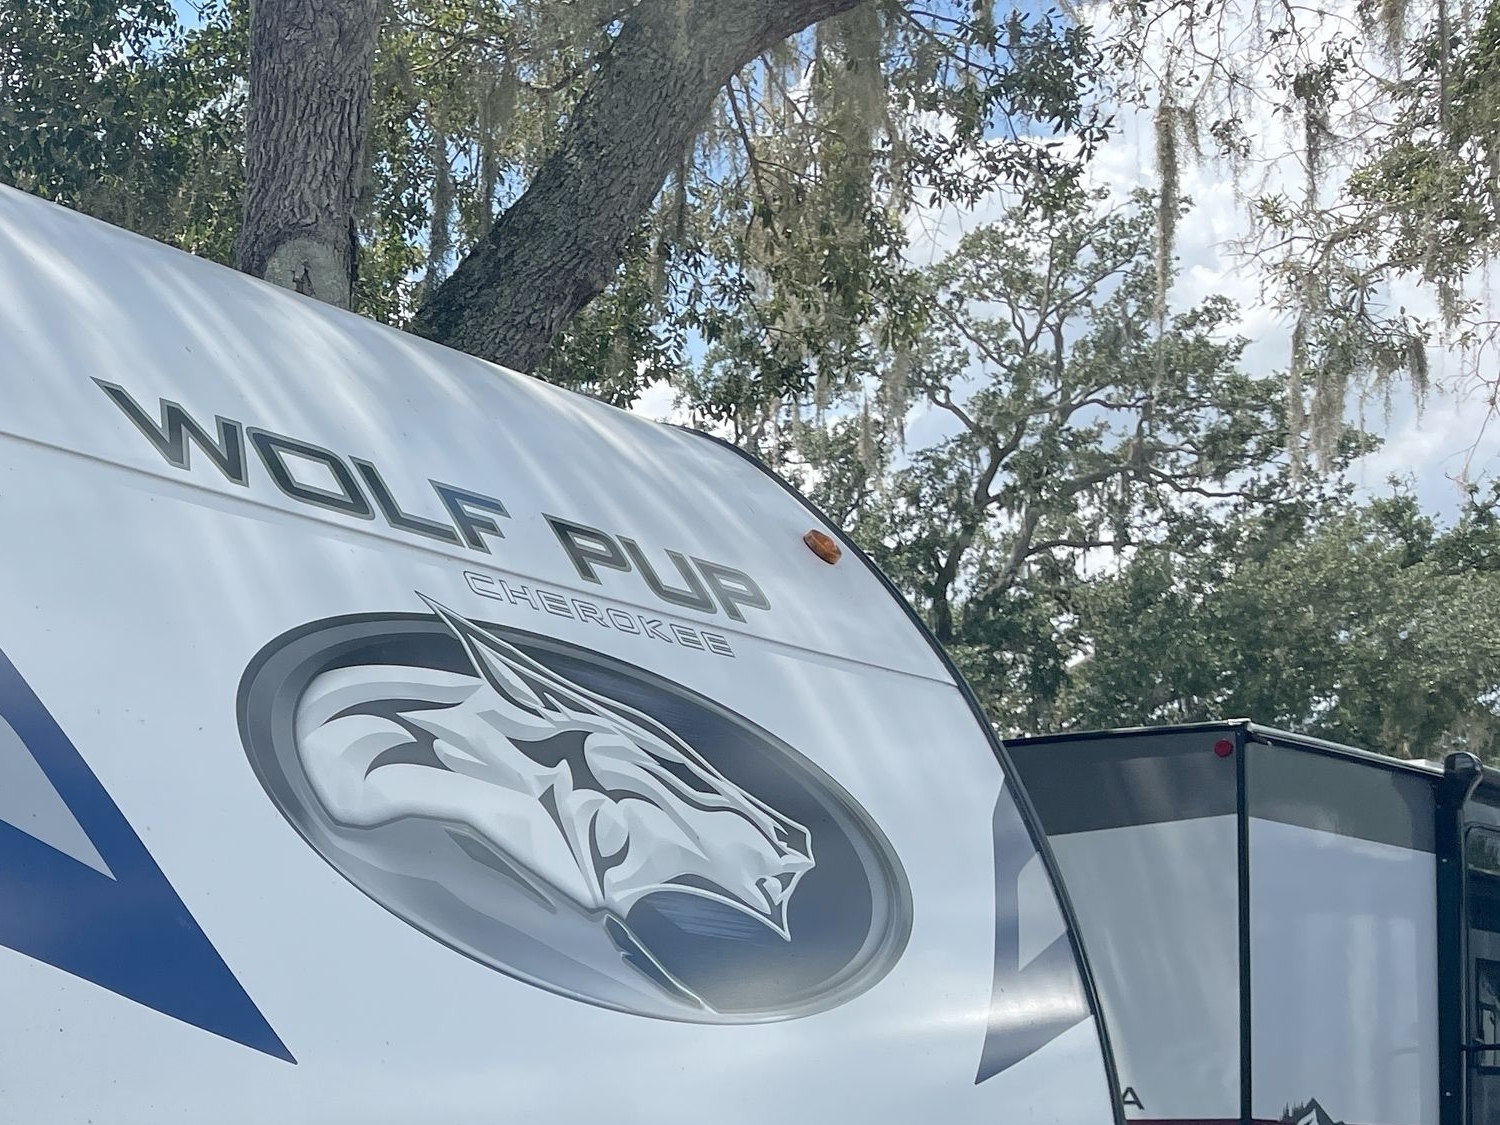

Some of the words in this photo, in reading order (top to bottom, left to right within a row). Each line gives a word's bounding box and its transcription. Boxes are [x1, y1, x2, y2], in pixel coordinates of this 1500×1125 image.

[90, 376, 512, 554] WOLF
[542, 512, 771, 623] PUP
[463, 569, 737, 658] CHEROKEE
